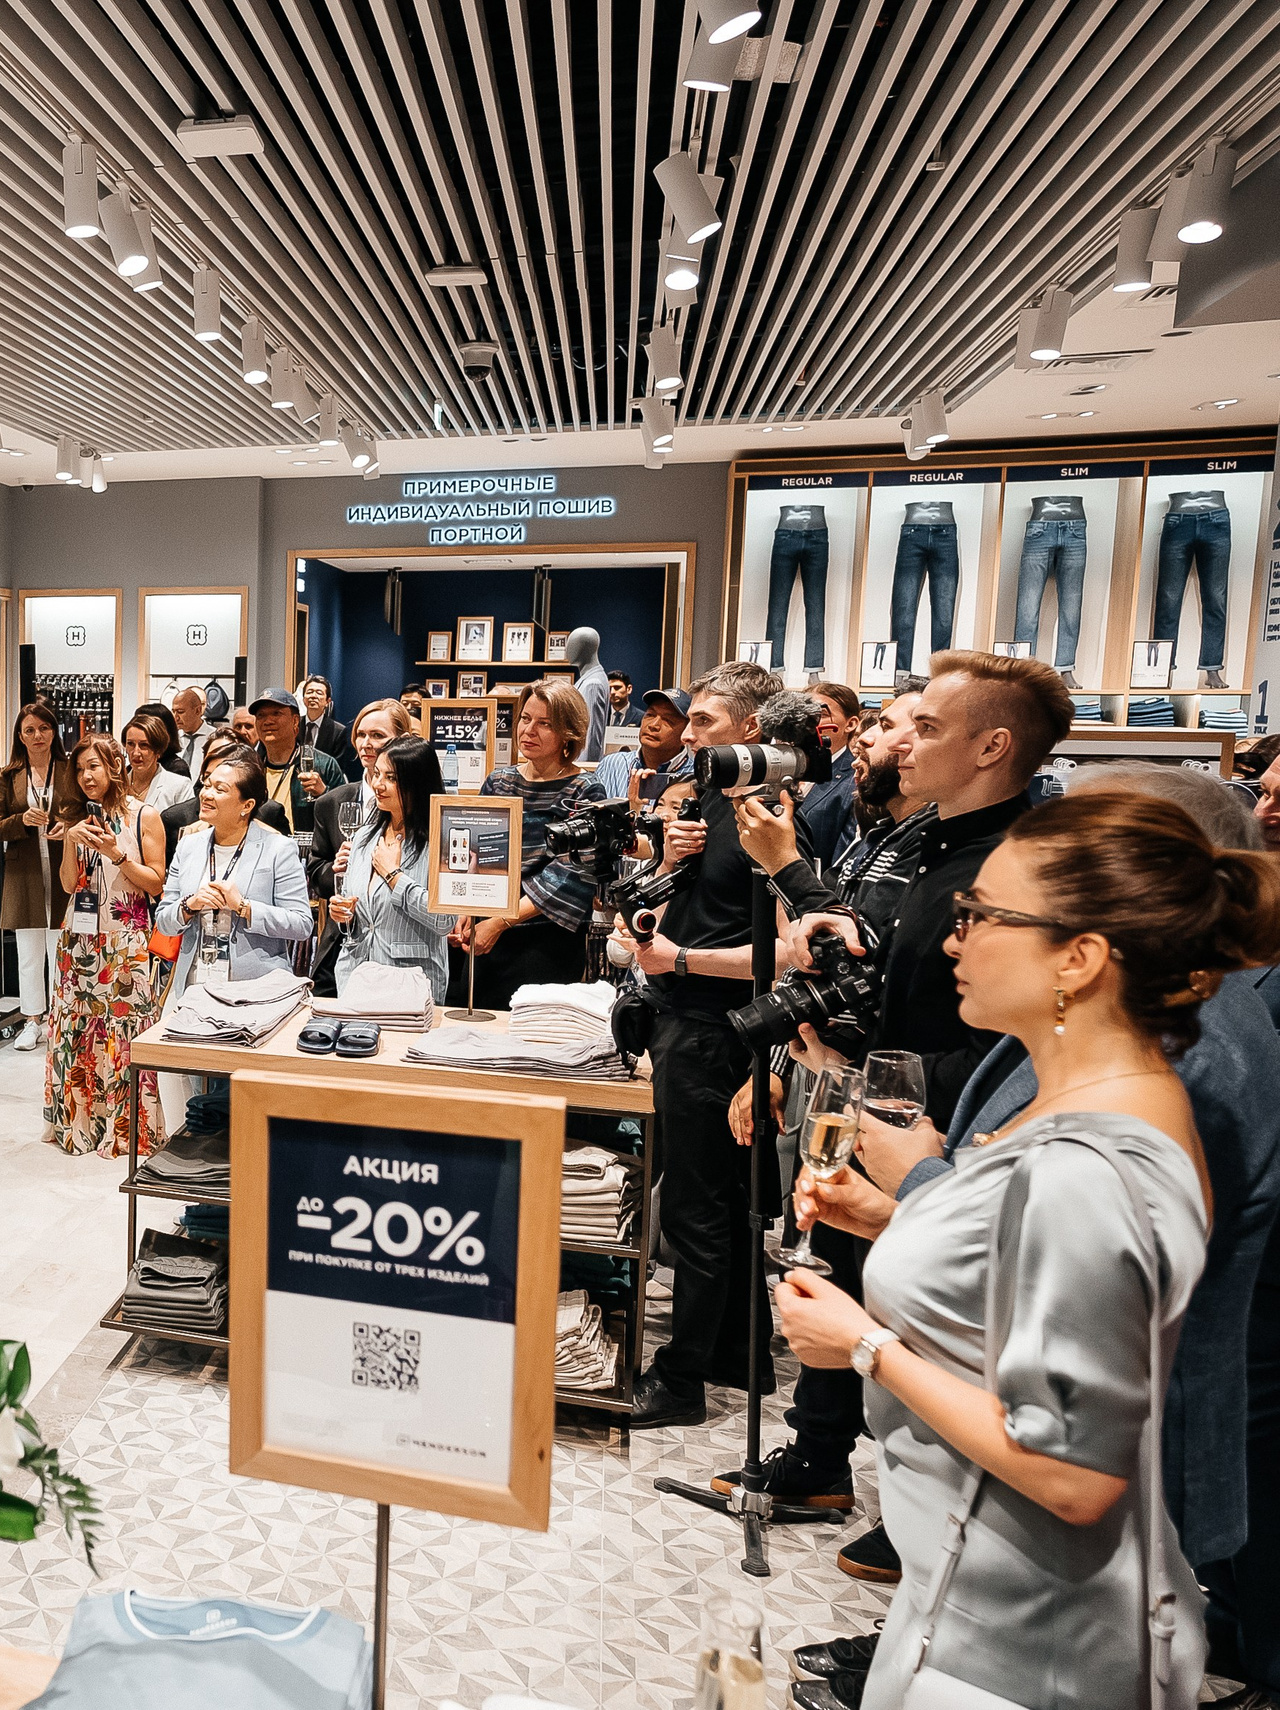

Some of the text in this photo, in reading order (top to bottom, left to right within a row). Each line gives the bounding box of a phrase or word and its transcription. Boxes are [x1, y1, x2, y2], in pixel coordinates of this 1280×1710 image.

[1061, 466, 1089, 477] SLIM
[1207, 460, 1237, 472] SLIM
[403, 476, 555, 496] ПРИМЕРОЧНЫЕ
[781, 476, 833, 487] REGULAR
[909, 471, 964, 483] REGULAR
[347, 498, 614, 523] ИНДИВИДУАЛЬНЫЙ ПОШИВ
[430, 523, 523, 543] ПОРТНОЙ
[72, 632, 80, 640] H
[192, 630, 201, 640] H
[1255, 679, 1269, 725] 1
[343, 1155, 439, 1185] АКЦИЯ
[296, 1196, 324, 1213] ДО
[297, 1196, 486, 1267] -20%
[288, 1249, 490, 1287] ПРИ ПОКУПКЕ ОТ ТРЕХ ИЗДЕЛИЙ
